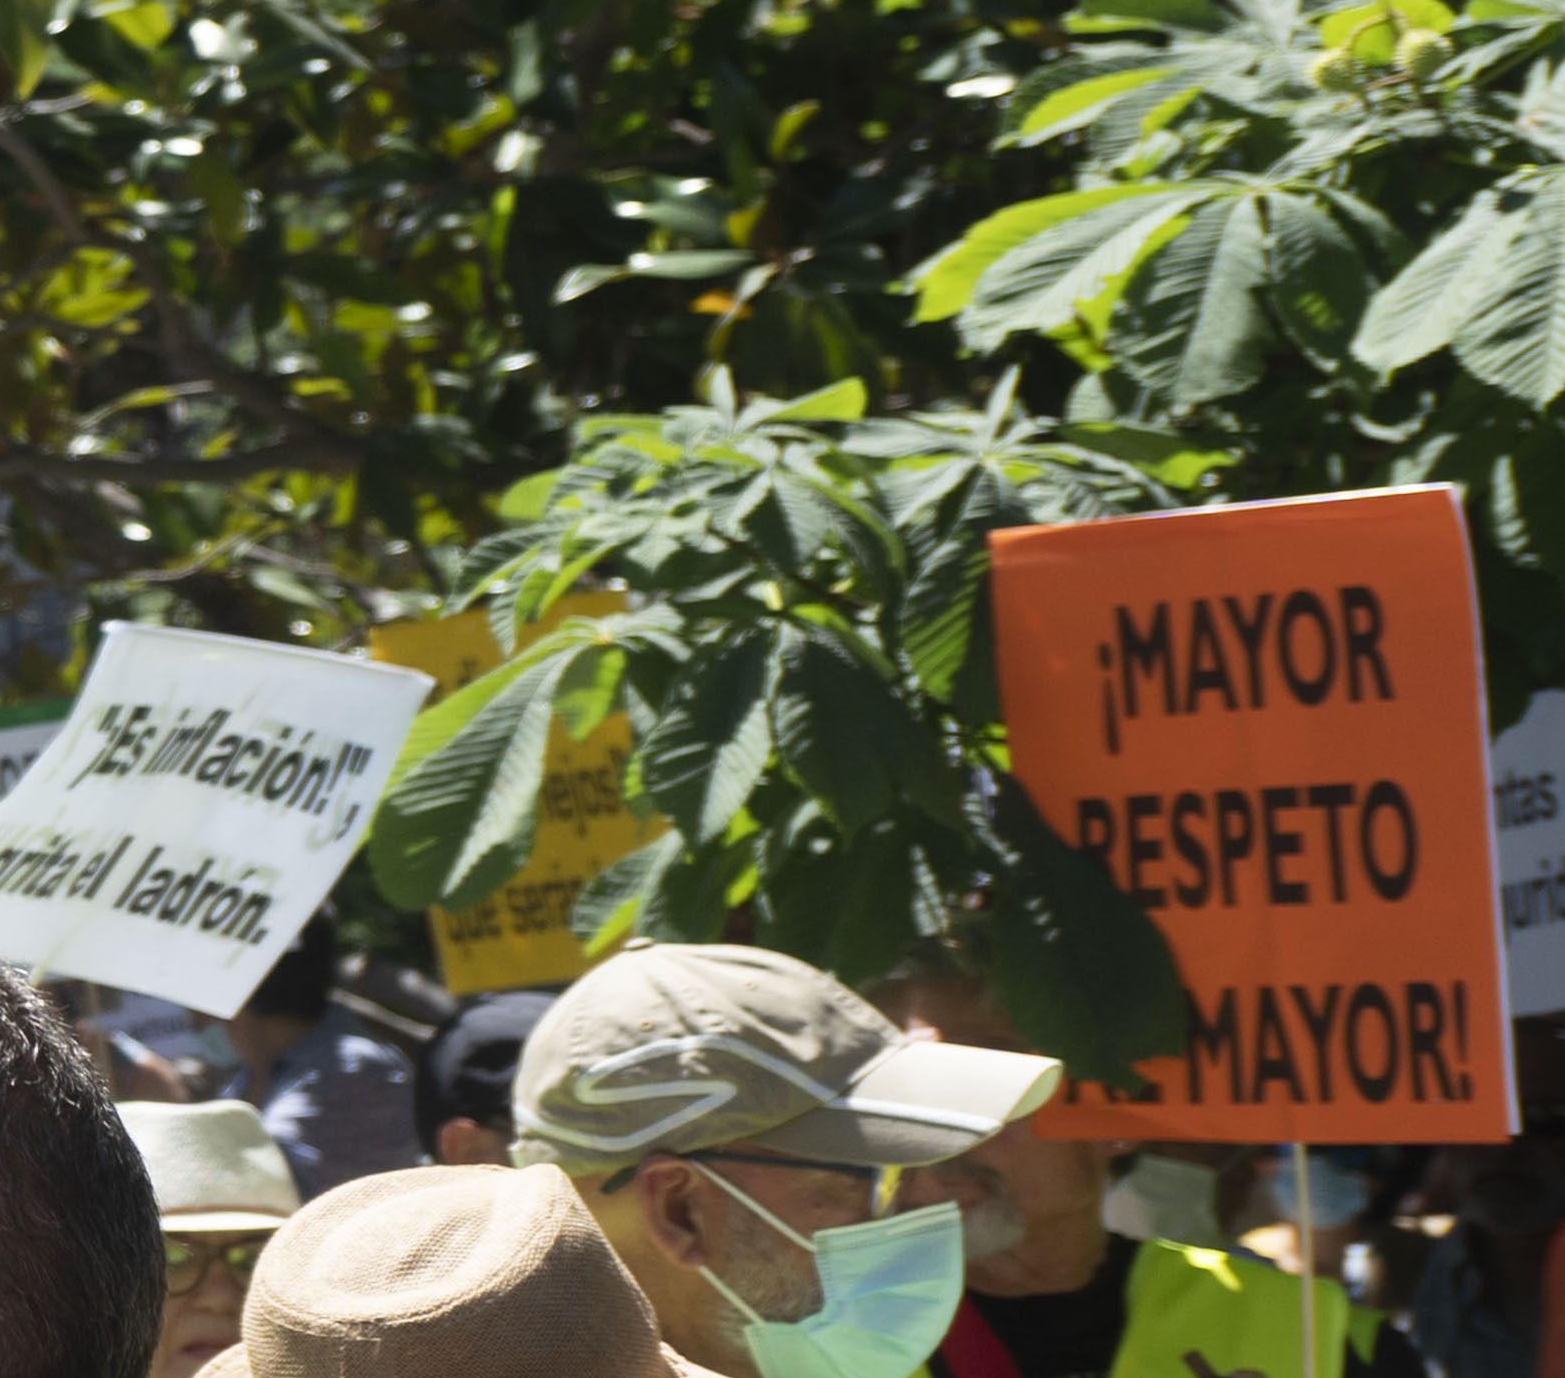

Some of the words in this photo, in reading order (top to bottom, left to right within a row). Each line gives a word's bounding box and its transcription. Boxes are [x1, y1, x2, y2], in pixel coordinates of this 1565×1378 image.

[1097, 585, 1395, 757] ¡MAYOR
[113, 844, 274, 945] ladrón.
[1187, 979, 1475, 1105] MAYOR!
